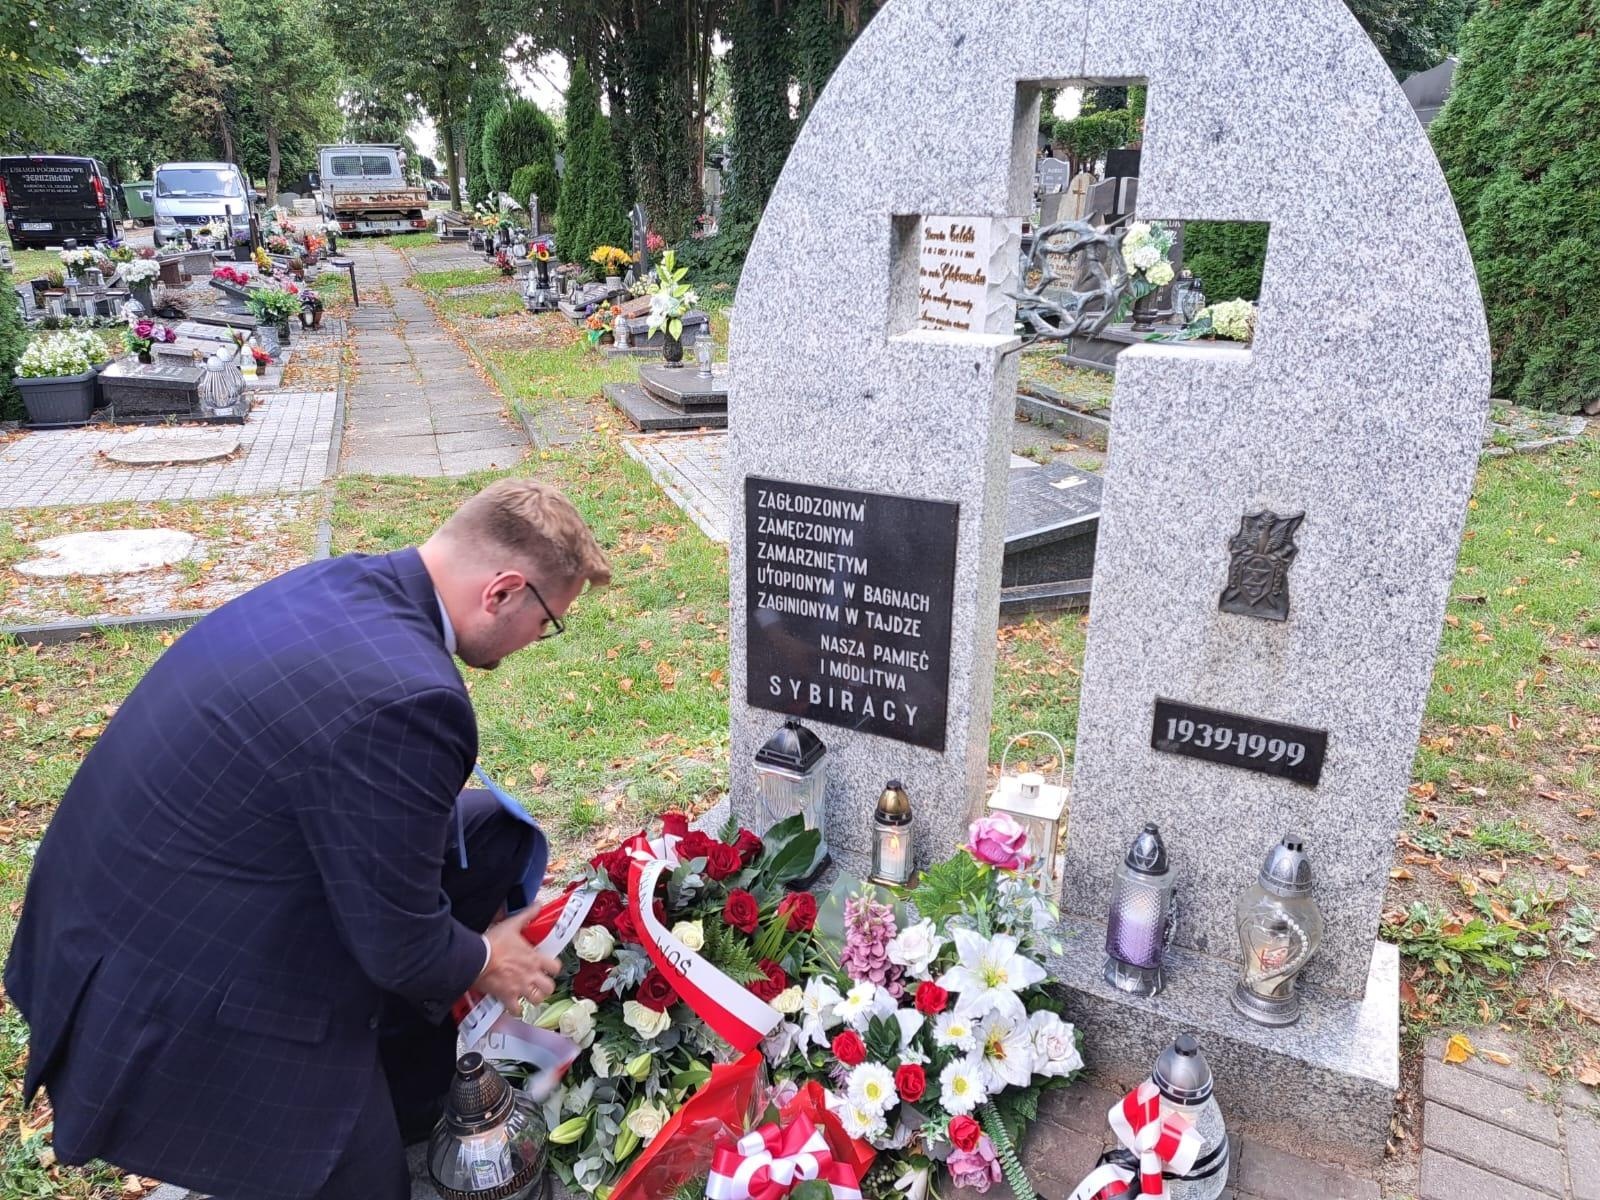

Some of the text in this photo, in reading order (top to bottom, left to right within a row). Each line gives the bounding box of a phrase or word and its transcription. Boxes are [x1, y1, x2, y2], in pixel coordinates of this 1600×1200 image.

[758, 490, 865, 522] ZAGŁODZONYM
[758, 516, 854, 547] ZAMĘCZONYM
[757, 541, 868, 576] ZAMARZNIĘTYM
[757, 567, 930, 612] UTOPIONYM W BAGNACH
[757, 592, 922, 638] ZAGINIONYM W TAJDZE
[820, 634, 930, 672] NASZA PAMIĘĆ
[820, 658, 906, 692] I MODLITWA
[769, 675, 918, 726] SYBIRACY
[1167, 718, 1306, 766] 1939-1999
